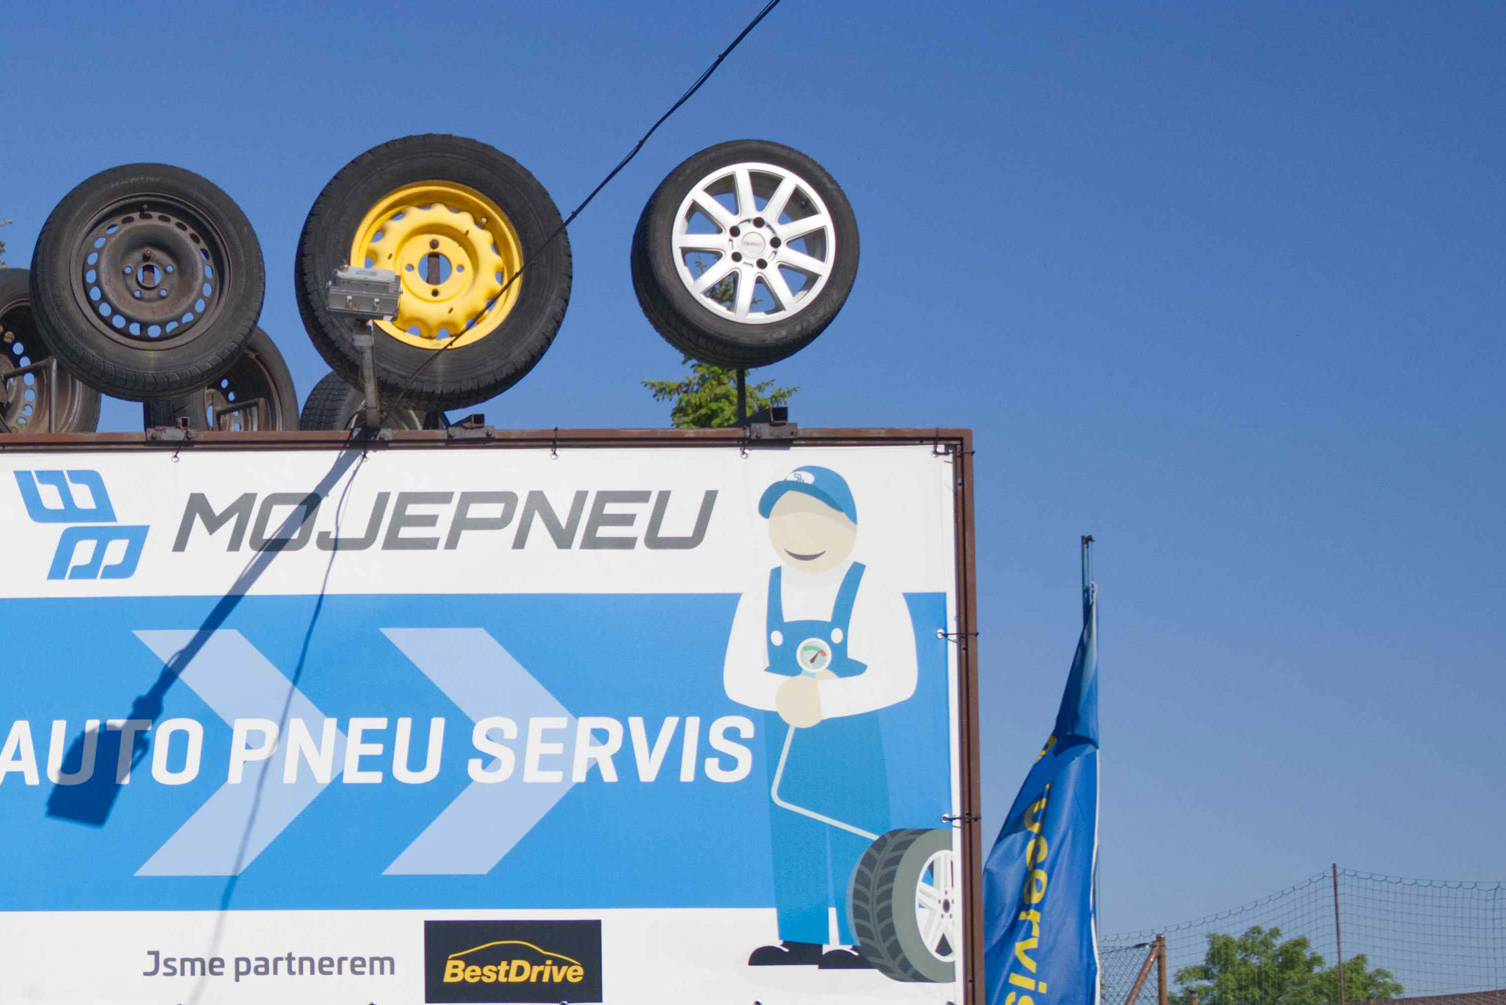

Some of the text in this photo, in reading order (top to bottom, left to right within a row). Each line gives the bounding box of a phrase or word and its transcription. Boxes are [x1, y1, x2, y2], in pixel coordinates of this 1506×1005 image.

[172, 490, 718, 552] MOJEPNEU
[227, 717, 446, 785] PNEU
[467, 715, 755, 783] SERVIS
[143, 950, 396, 983] Jsme partnerem
[443, 959, 584, 983] BestDrive
